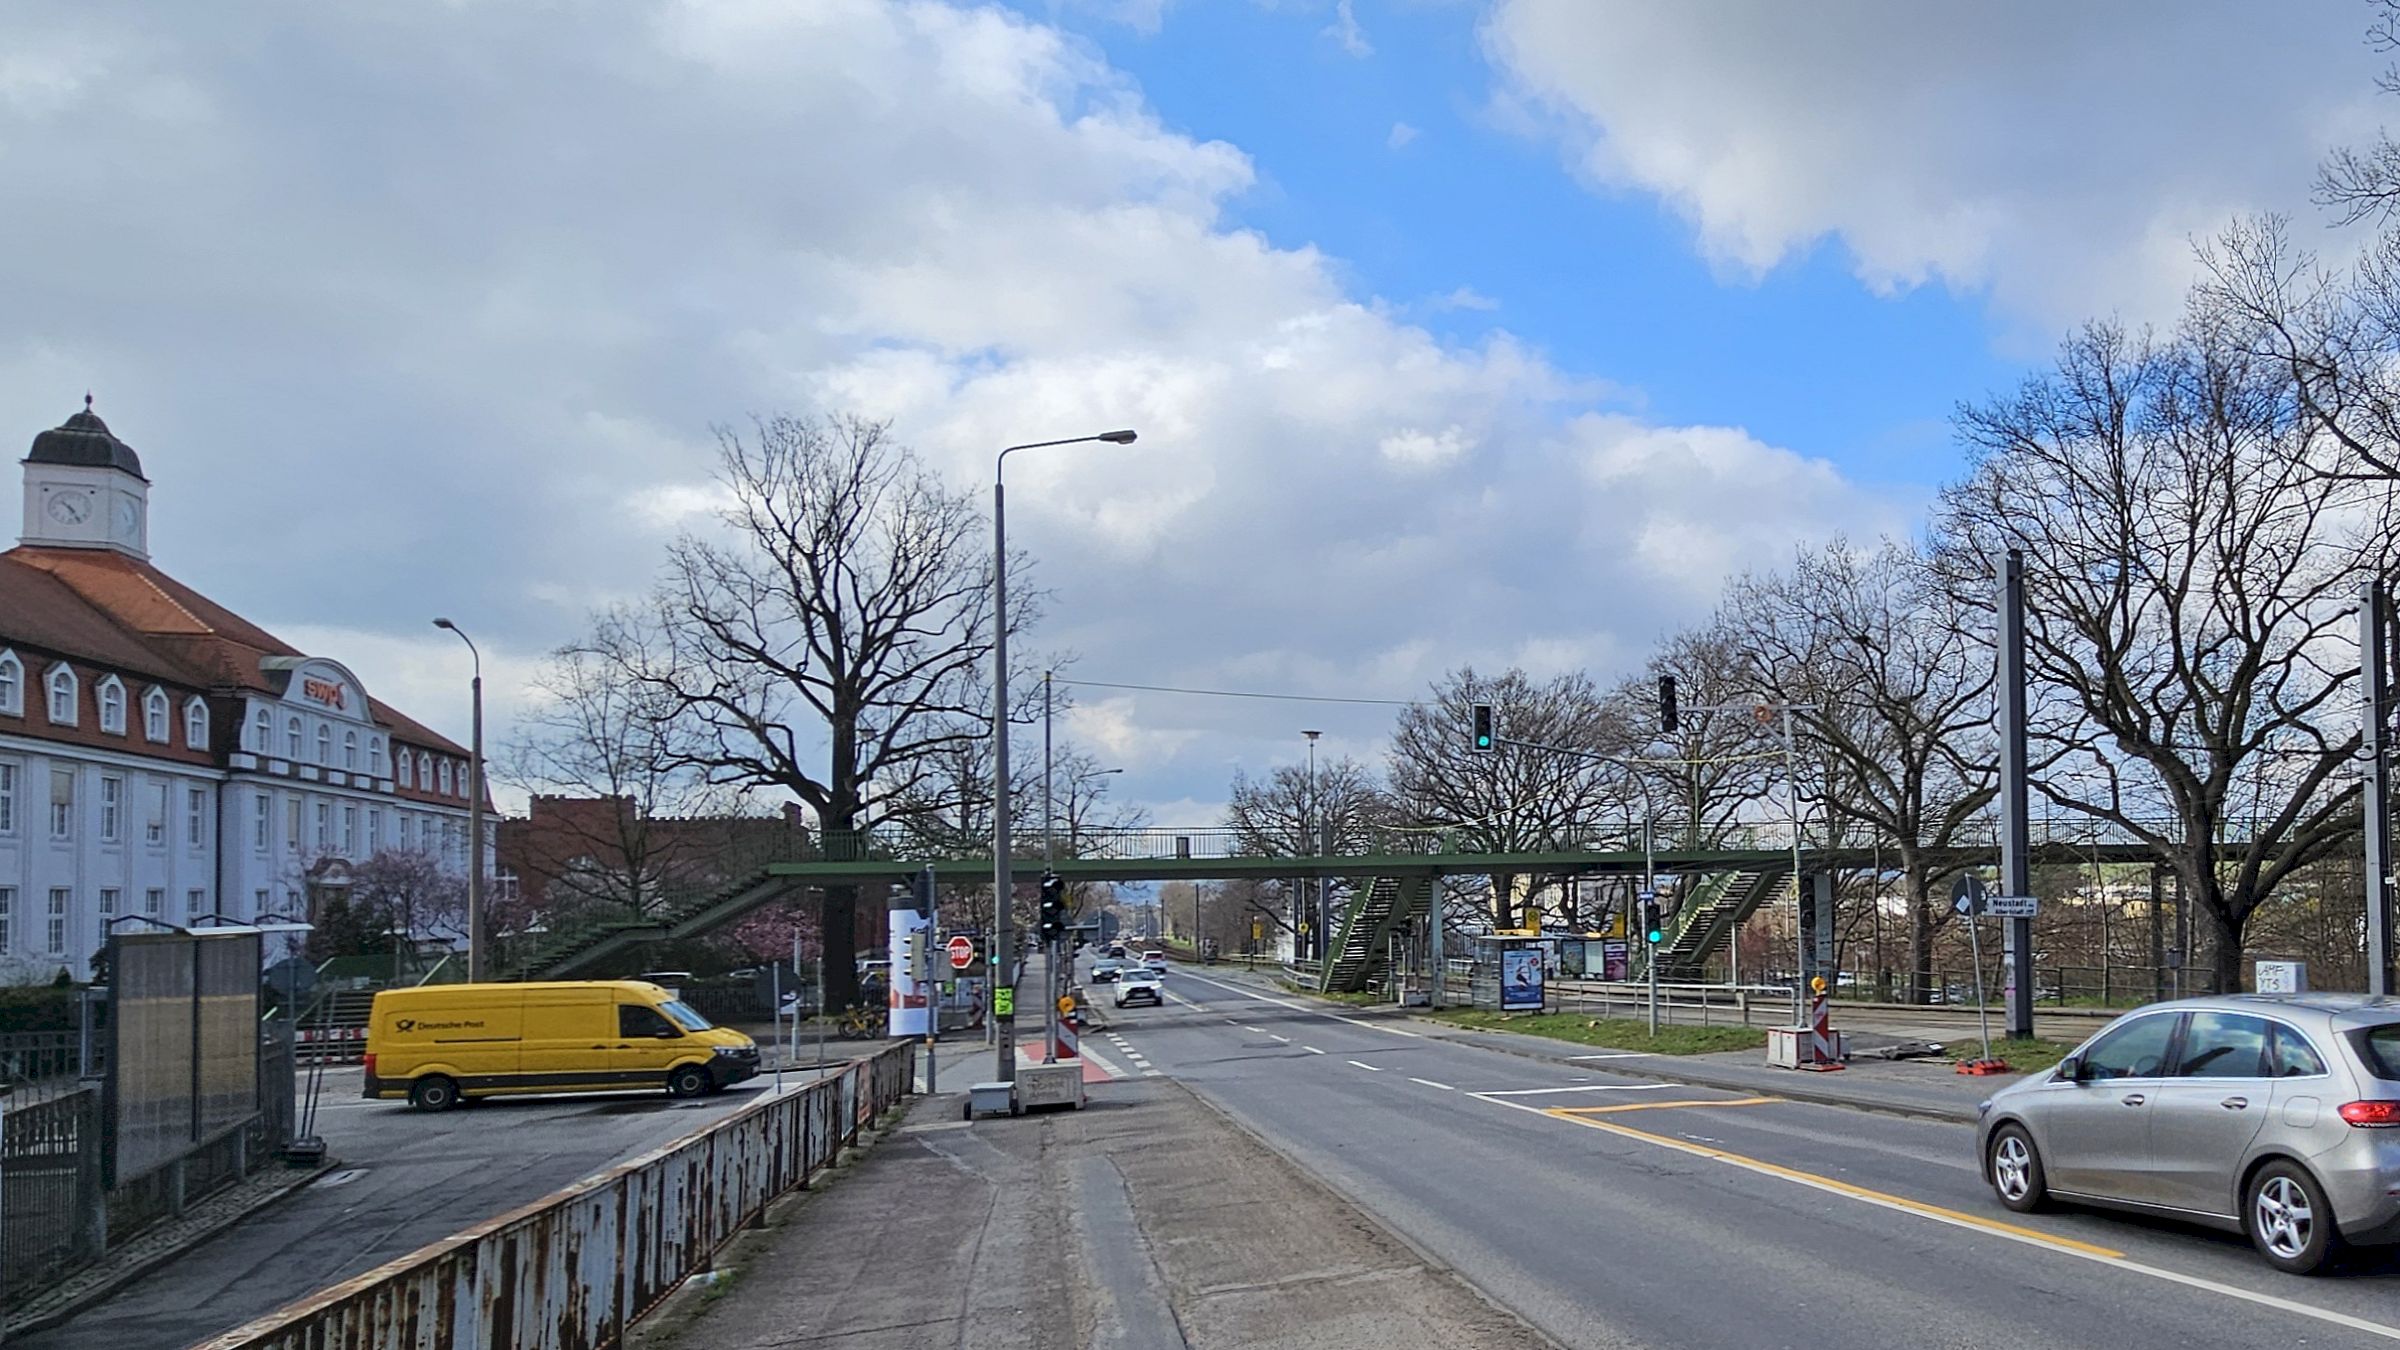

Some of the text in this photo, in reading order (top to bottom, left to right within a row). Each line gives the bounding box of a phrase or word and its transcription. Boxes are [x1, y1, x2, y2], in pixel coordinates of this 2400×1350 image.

[305, 680, 338, 706] swp
[1993, 899, 2027, 907] Neustadt
[950, 946, 970, 959] STOP
[418, 1020, 484, 1030] Deutsche Post
